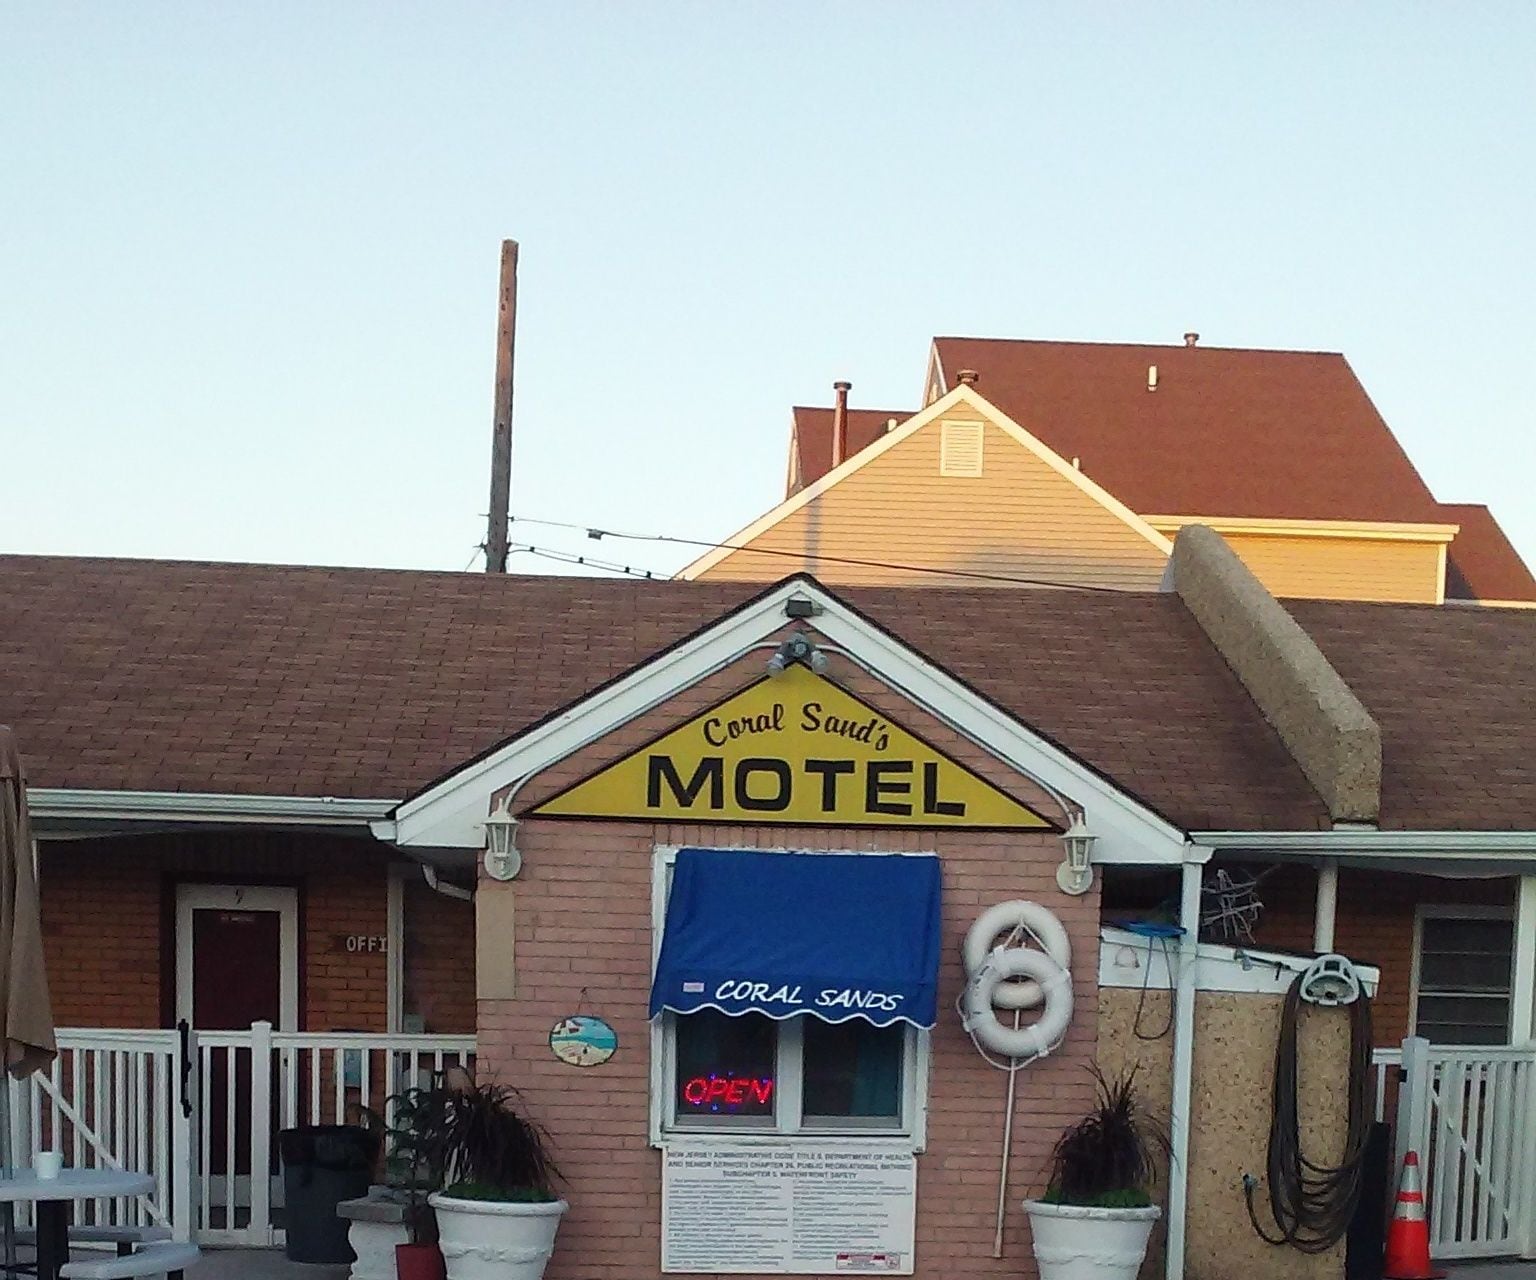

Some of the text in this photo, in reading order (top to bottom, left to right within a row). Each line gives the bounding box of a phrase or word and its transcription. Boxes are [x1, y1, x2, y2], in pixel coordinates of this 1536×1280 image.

[703, 703, 890, 751] Coral Sand's
[646, 755, 967, 817] MOTEL
[346, 936, 387, 952] OFFI
[715, 980, 904, 1011] CORAL SANDS
[684, 1077, 774, 1104] OPEN
